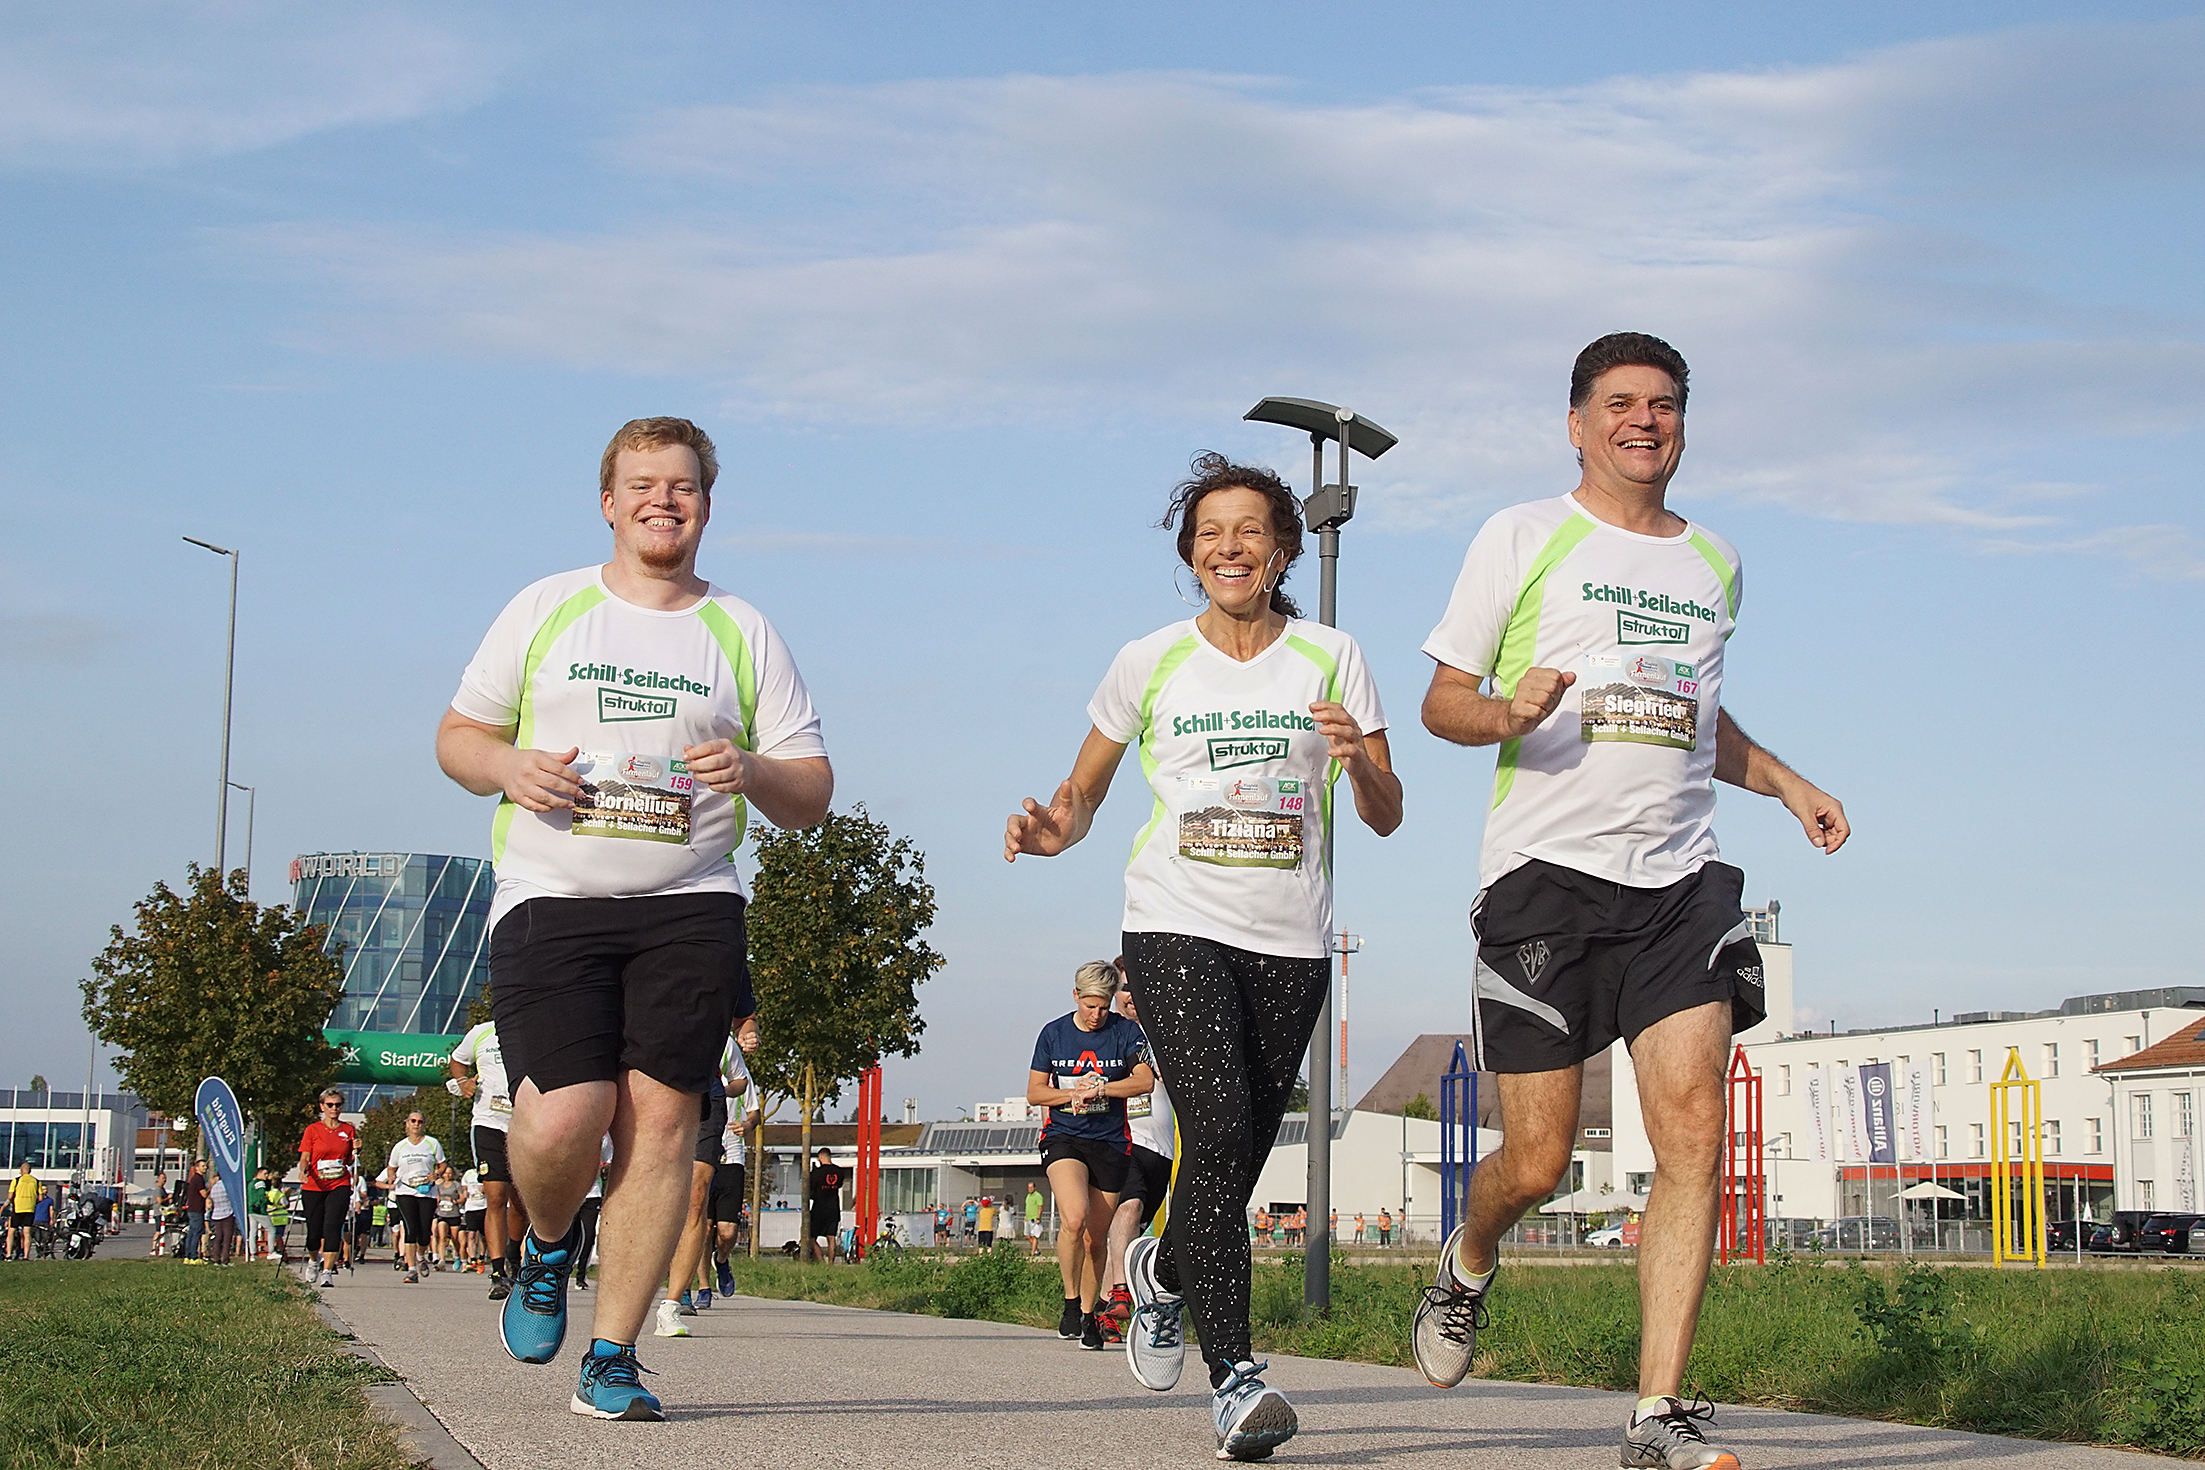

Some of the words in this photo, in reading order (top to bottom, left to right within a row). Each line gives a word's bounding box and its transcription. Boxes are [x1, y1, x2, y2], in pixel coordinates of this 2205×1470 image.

[1676, 679, 1698, 695] 167
[1604, 694, 1683, 719] Siegfried
[1591, 723, 1618, 733] Schill
[1629, 724, 1669, 737] Seilacher
[670, 775, 693, 791] 159
[593, 791, 675, 815] Cornelius
[1279, 796, 1304, 811] 148
[582, 818, 606, 829] Schill
[616, 820, 657, 834] Seilacher
[658, 826, 682, 837] GmbH
[1210, 819, 1276, 839] Tiziana
[1189, 846, 1216, 858] Schill
[1226, 847, 1269, 859] Seilacher
[1270, 850, 1295, 860] GmbH
